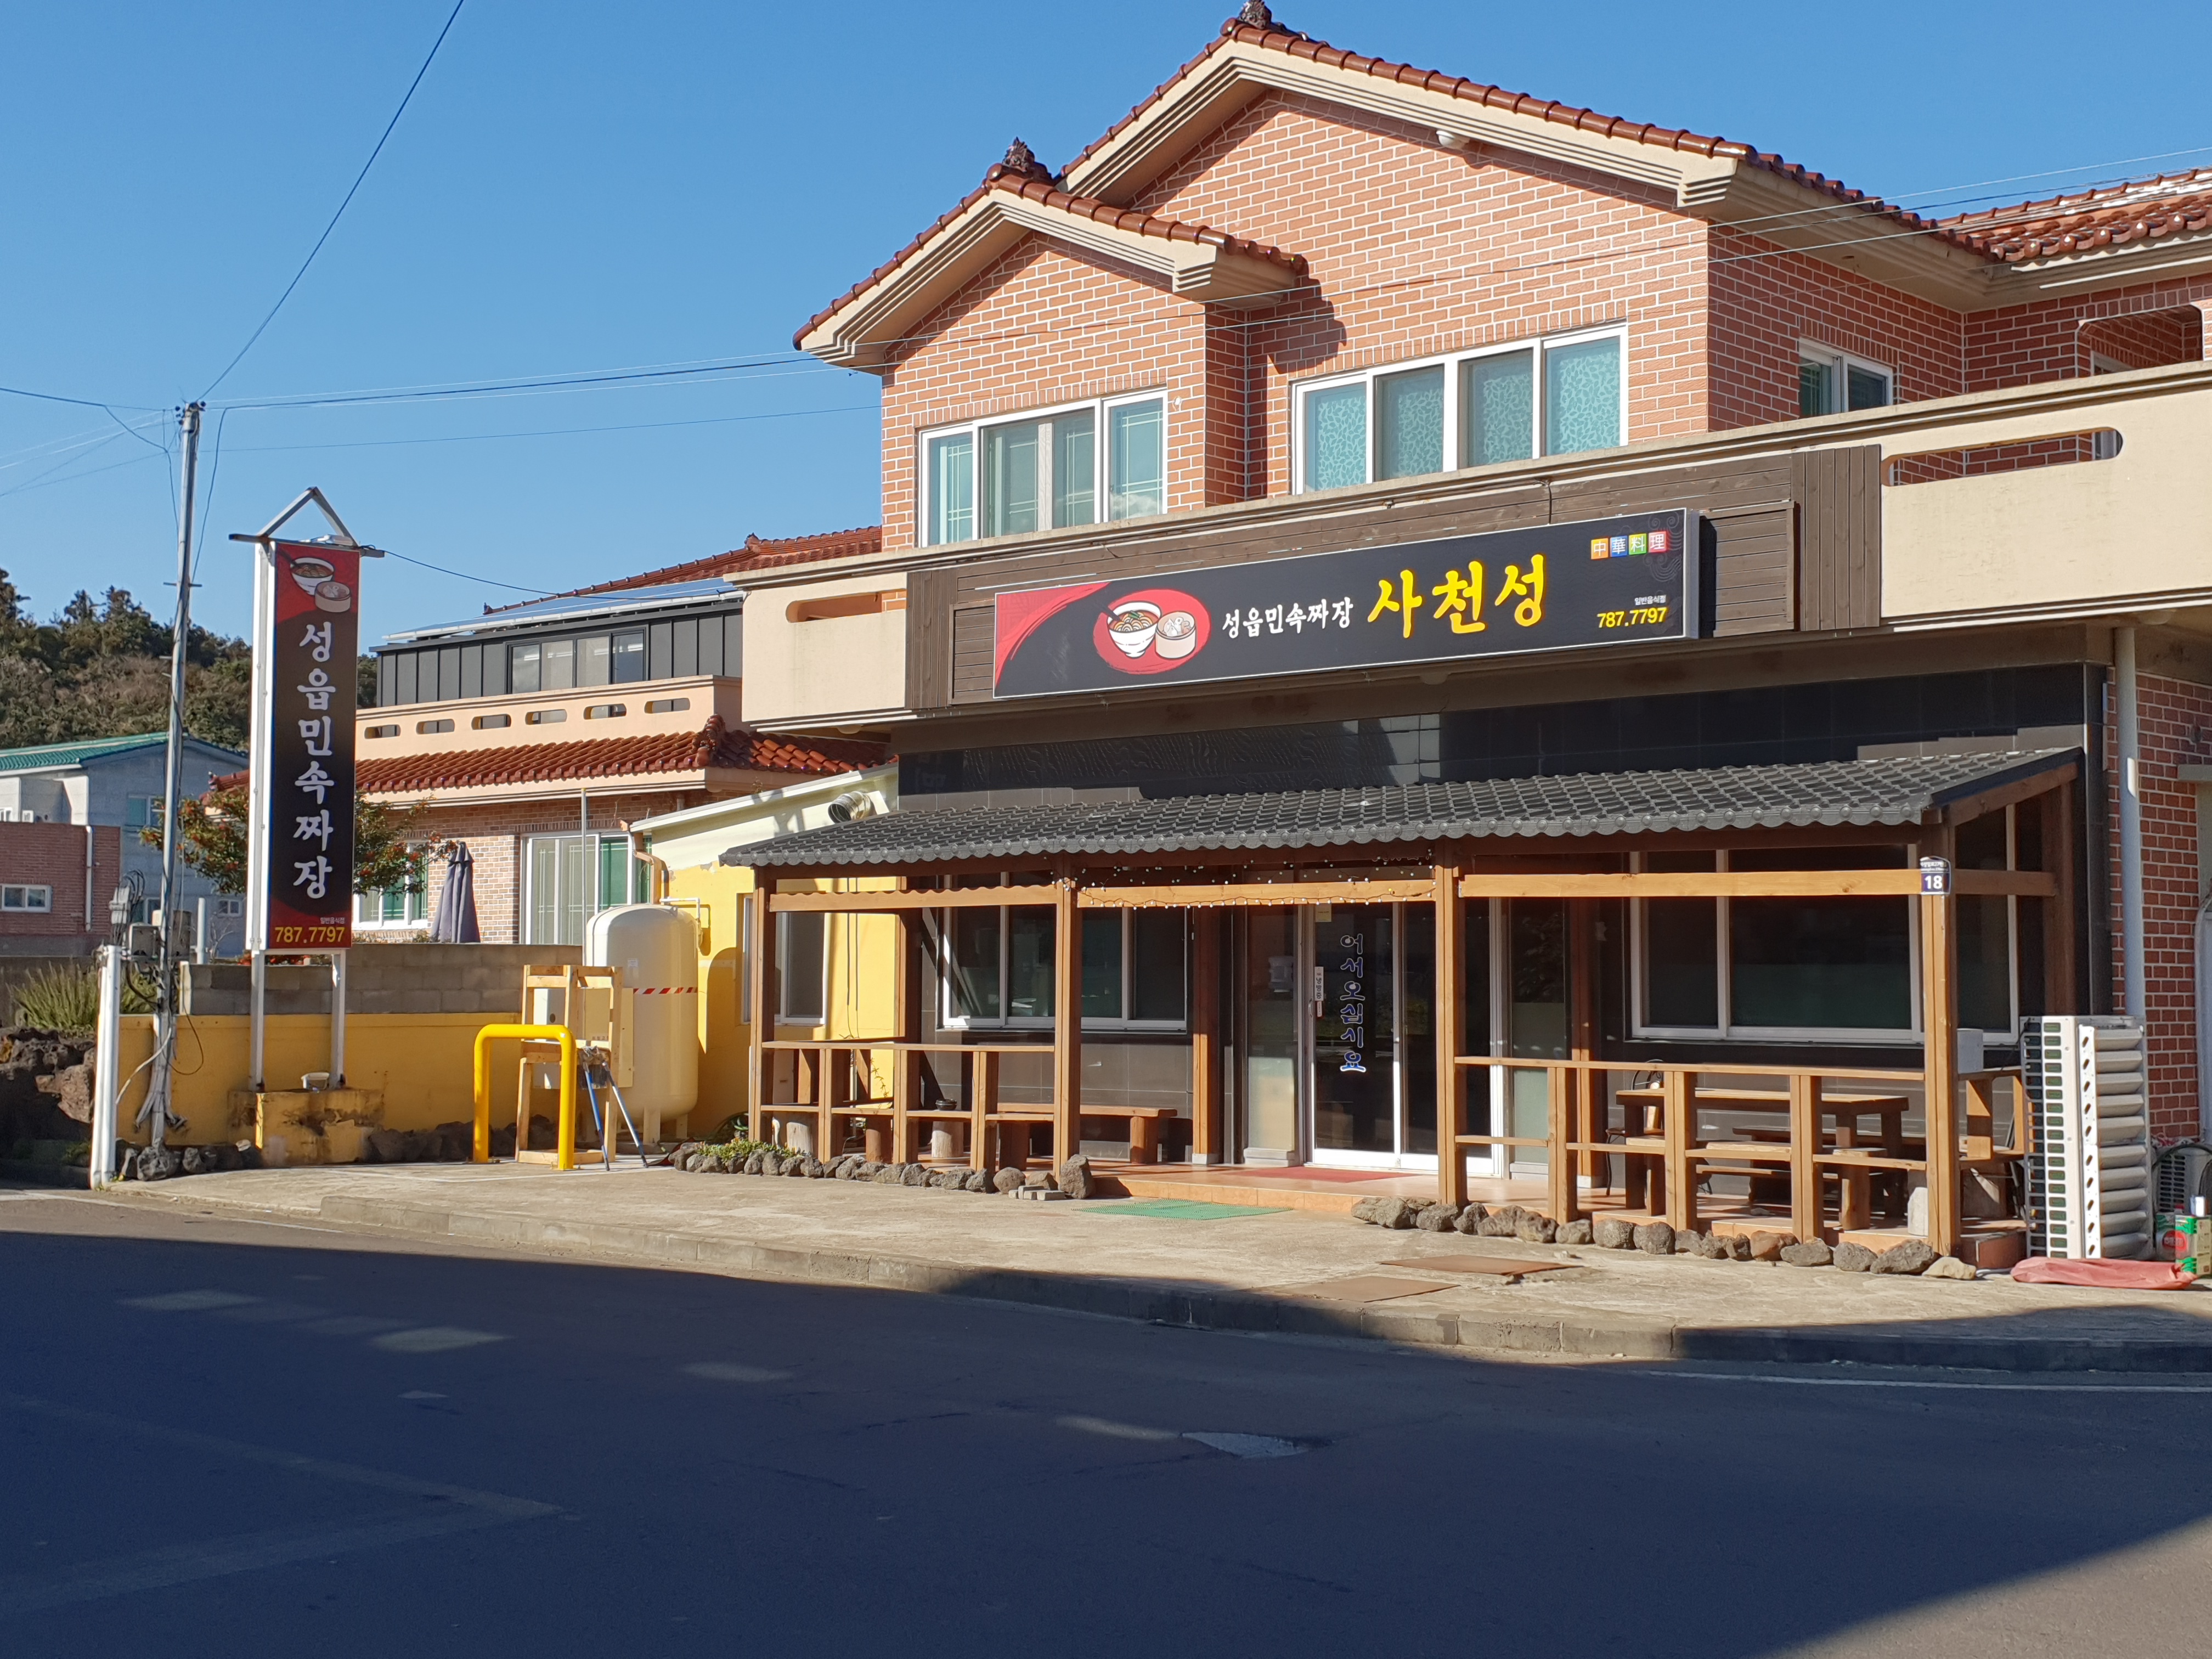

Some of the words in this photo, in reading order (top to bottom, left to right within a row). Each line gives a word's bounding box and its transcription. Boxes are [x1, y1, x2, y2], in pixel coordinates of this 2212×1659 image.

[1593, 533, 1665, 556] 中華料理
[1368, 554, 1544, 639] 사천성
[1634, 595, 1666, 606] 일반음식점
[1222, 596, 1353, 639] 성읍민속짜장
[1597, 607, 1667, 628] 787.7797
[293, 622, 336, 900] 성읍민속짜장
[1925, 875, 1943, 889] 18
[275, 926, 345, 943] 787.7797
[1340, 933, 1366, 1073] 어서오십시요
